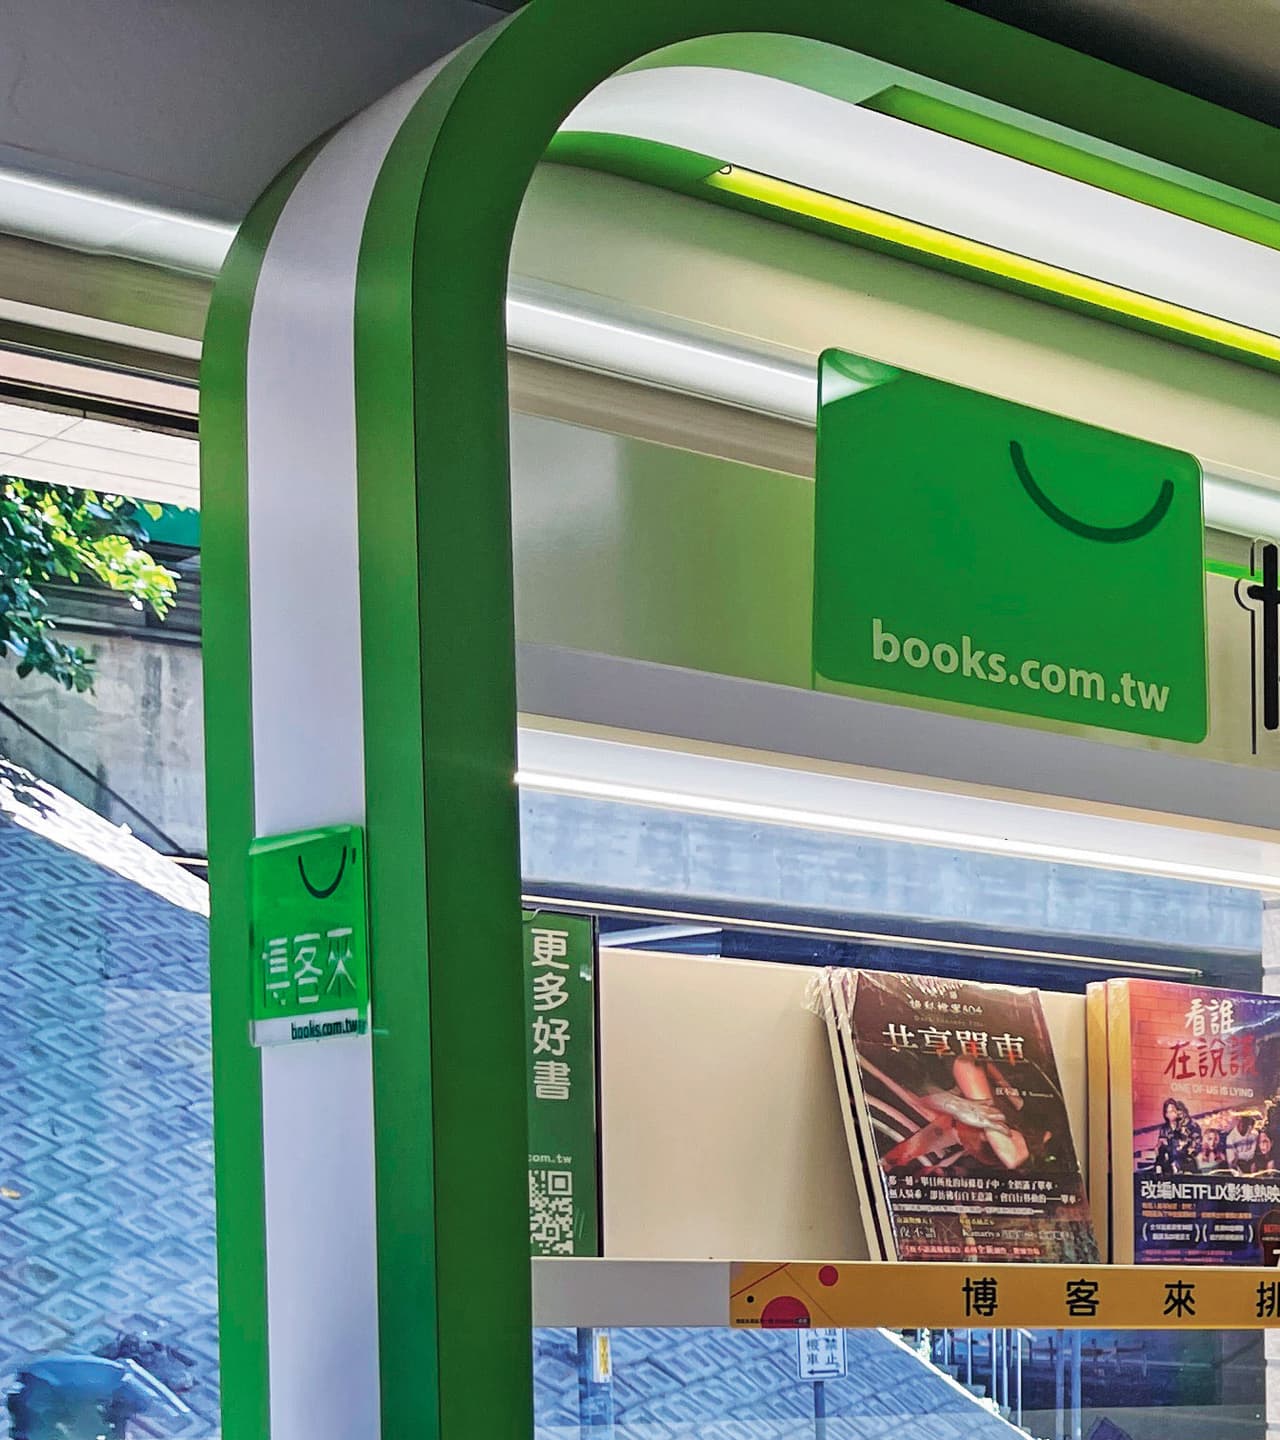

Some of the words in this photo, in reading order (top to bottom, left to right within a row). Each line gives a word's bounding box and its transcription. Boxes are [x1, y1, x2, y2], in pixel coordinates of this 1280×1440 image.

[871, 618, 1170, 713] books.com.tw
[531, 927, 571, 1100] 更多好書
[1183, 998, 1235, 1038] 看誰
[1163, 1036, 1260, 1081] 在說謊
[1229, 1087, 1254, 1099] LYING
